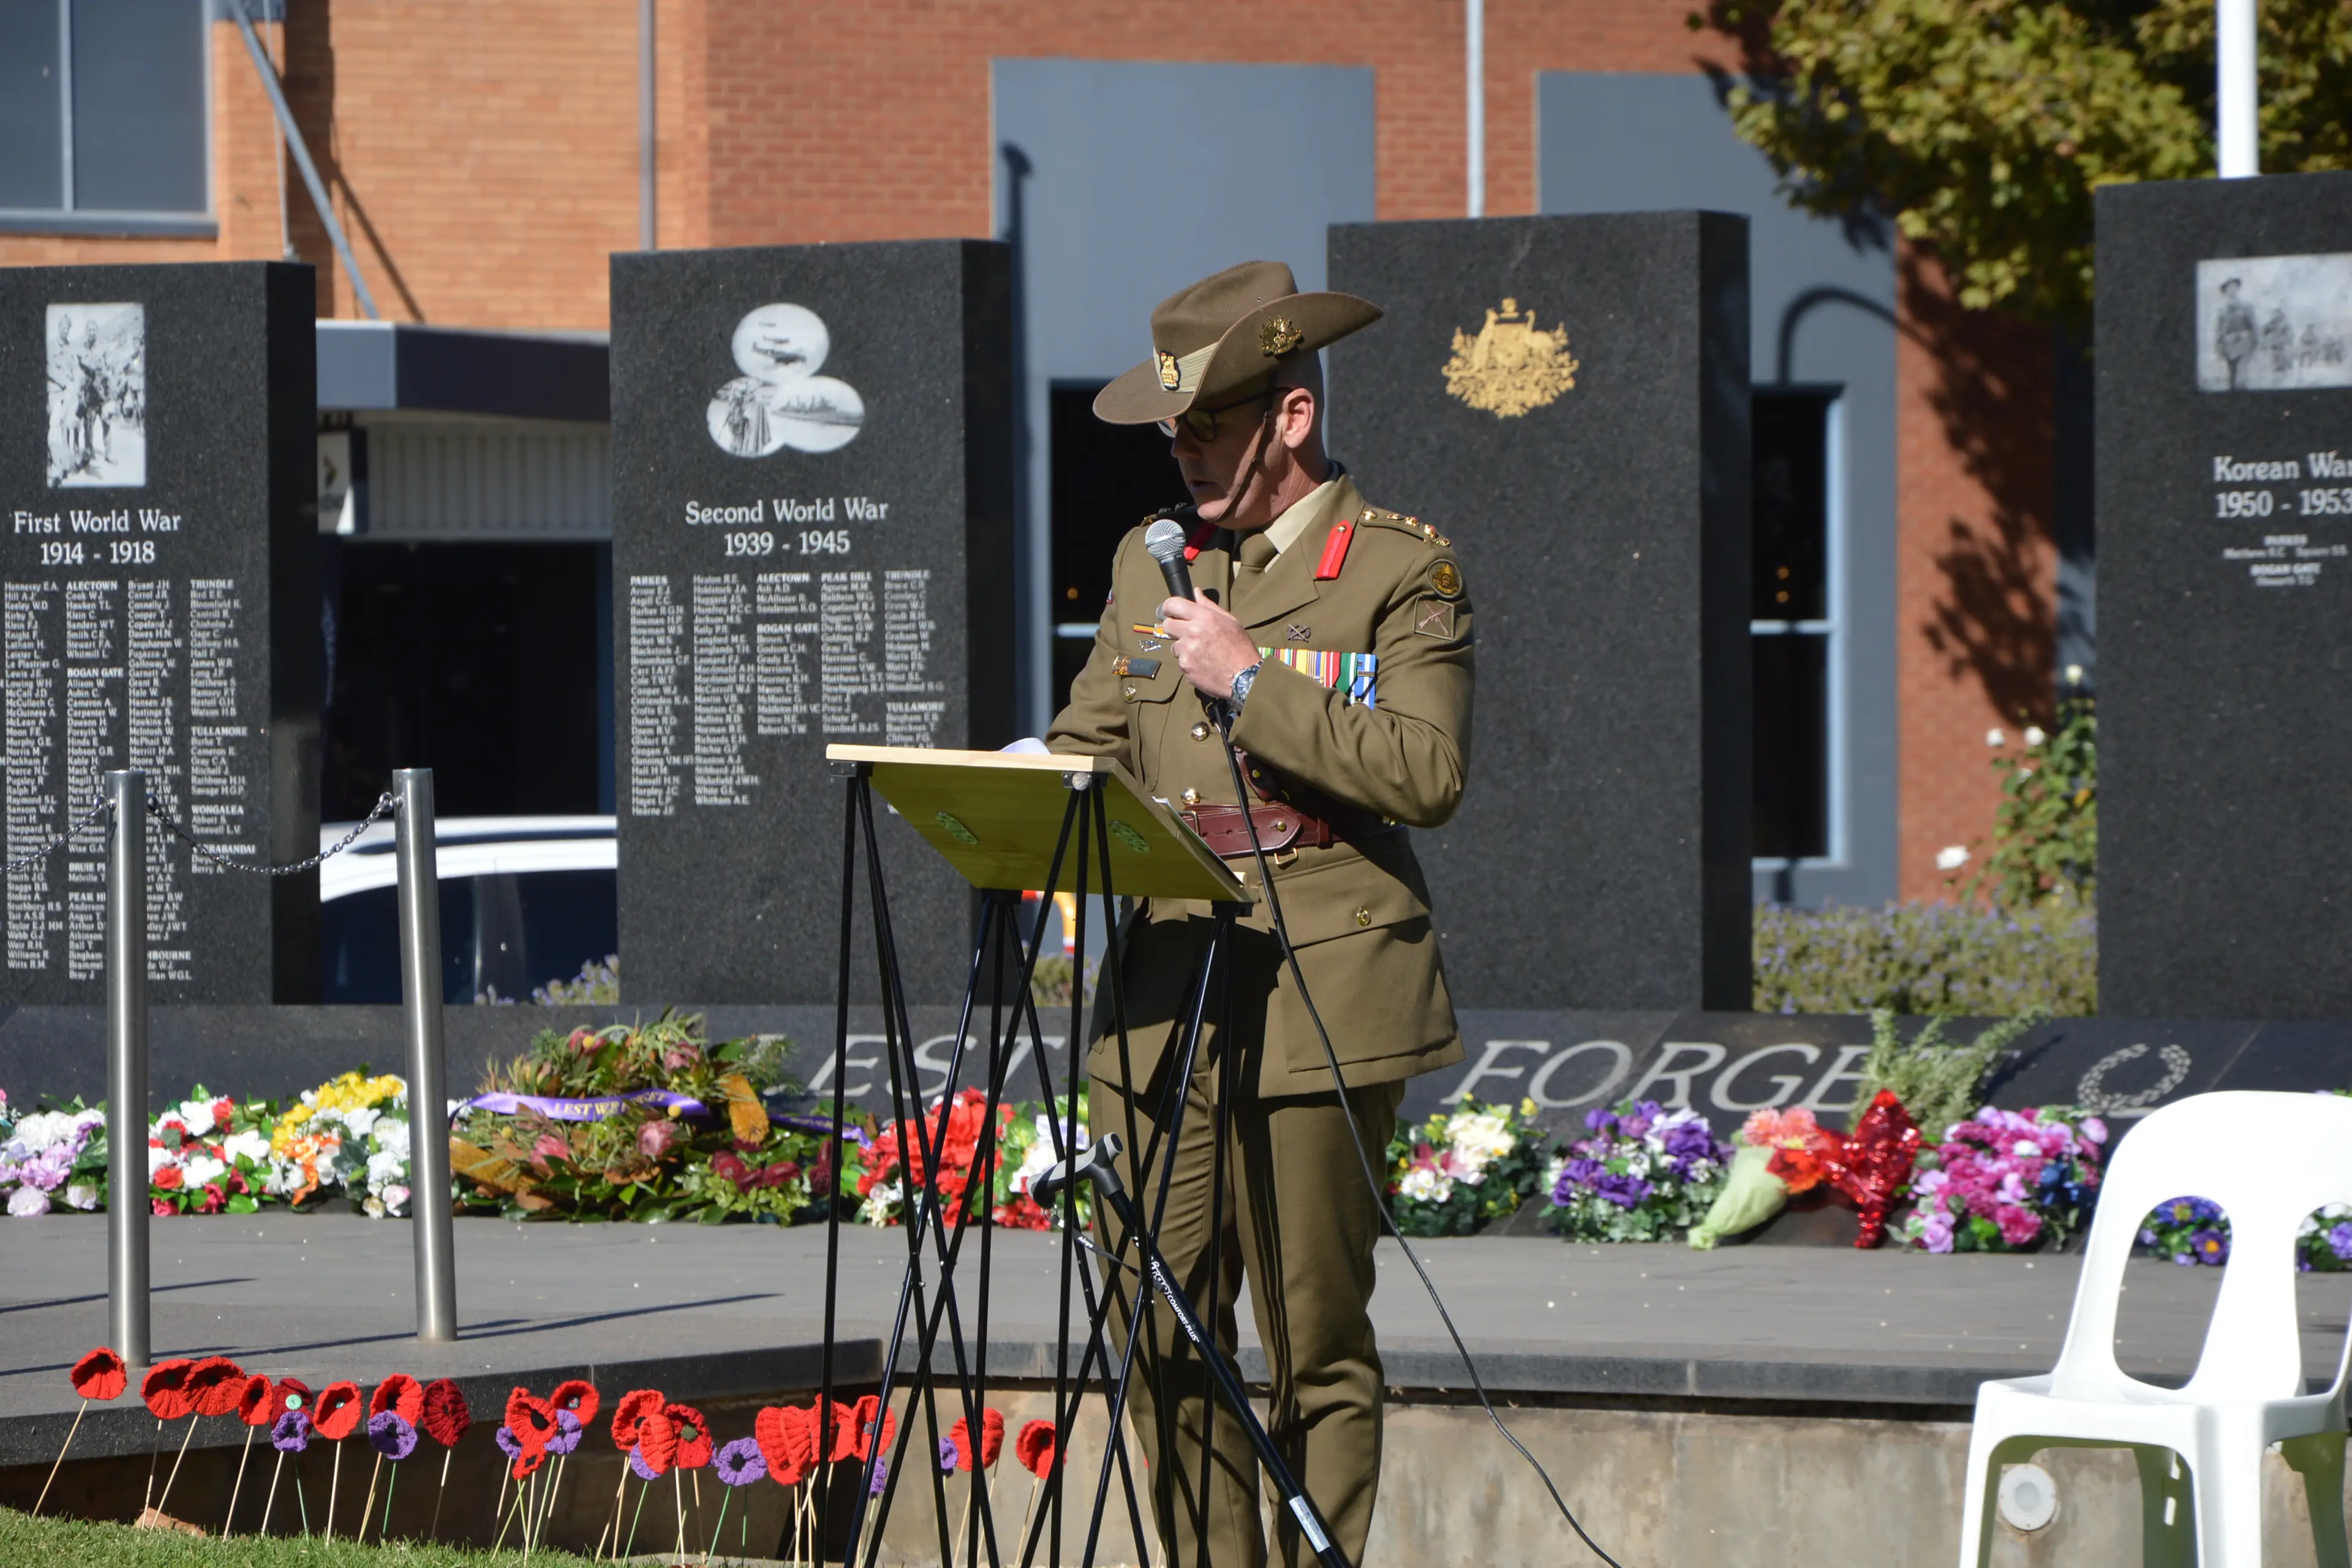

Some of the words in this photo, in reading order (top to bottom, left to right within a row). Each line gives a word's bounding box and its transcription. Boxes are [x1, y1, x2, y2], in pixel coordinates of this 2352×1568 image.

[2214, 455, 2300, 482] Korean
[2215, 491, 2274, 518] 1950
[2299, 488, 2352, 515] 1953
[685, 499, 764, 524] Second
[773, 497, 835, 522] World
[843, 496, 889, 521] War
[14, 511, 60, 533] First
[70, 510, 129, 533] World
[138, 509, 181, 532] War
[724, 532, 774, 556] 1939
[799, 530, 851, 554] 1945
[40, 542, 84, 564] 1914
[110, 541, 156, 563] 1918
[757, 573, 810, 583] ALECTOWN
[821, 572, 848, 582] PEAK
[67, 581, 118, 591] ALECTOWN
[190, 579, 233, 589] TRUNDLE
[757, 624, 791, 634] BOGAN
[795, 623, 818, 633] GATE
[67, 668, 99, 677] BOGAN
[101, 668, 123, 677] GATE
[887, 702, 944, 712] TULLAMORE
[191, 726, 247, 736] TULLAMORE
[192, 805, 244, 815] WONGALEA
[69, 892, 93, 902] PEAK
[8, 950, 40, 959] Williams
[748, 1033, 1065, 1099] EST
[554, 1102, 594, 1116] LEST
[1077, 1236, 1093, 1248] Airgo
